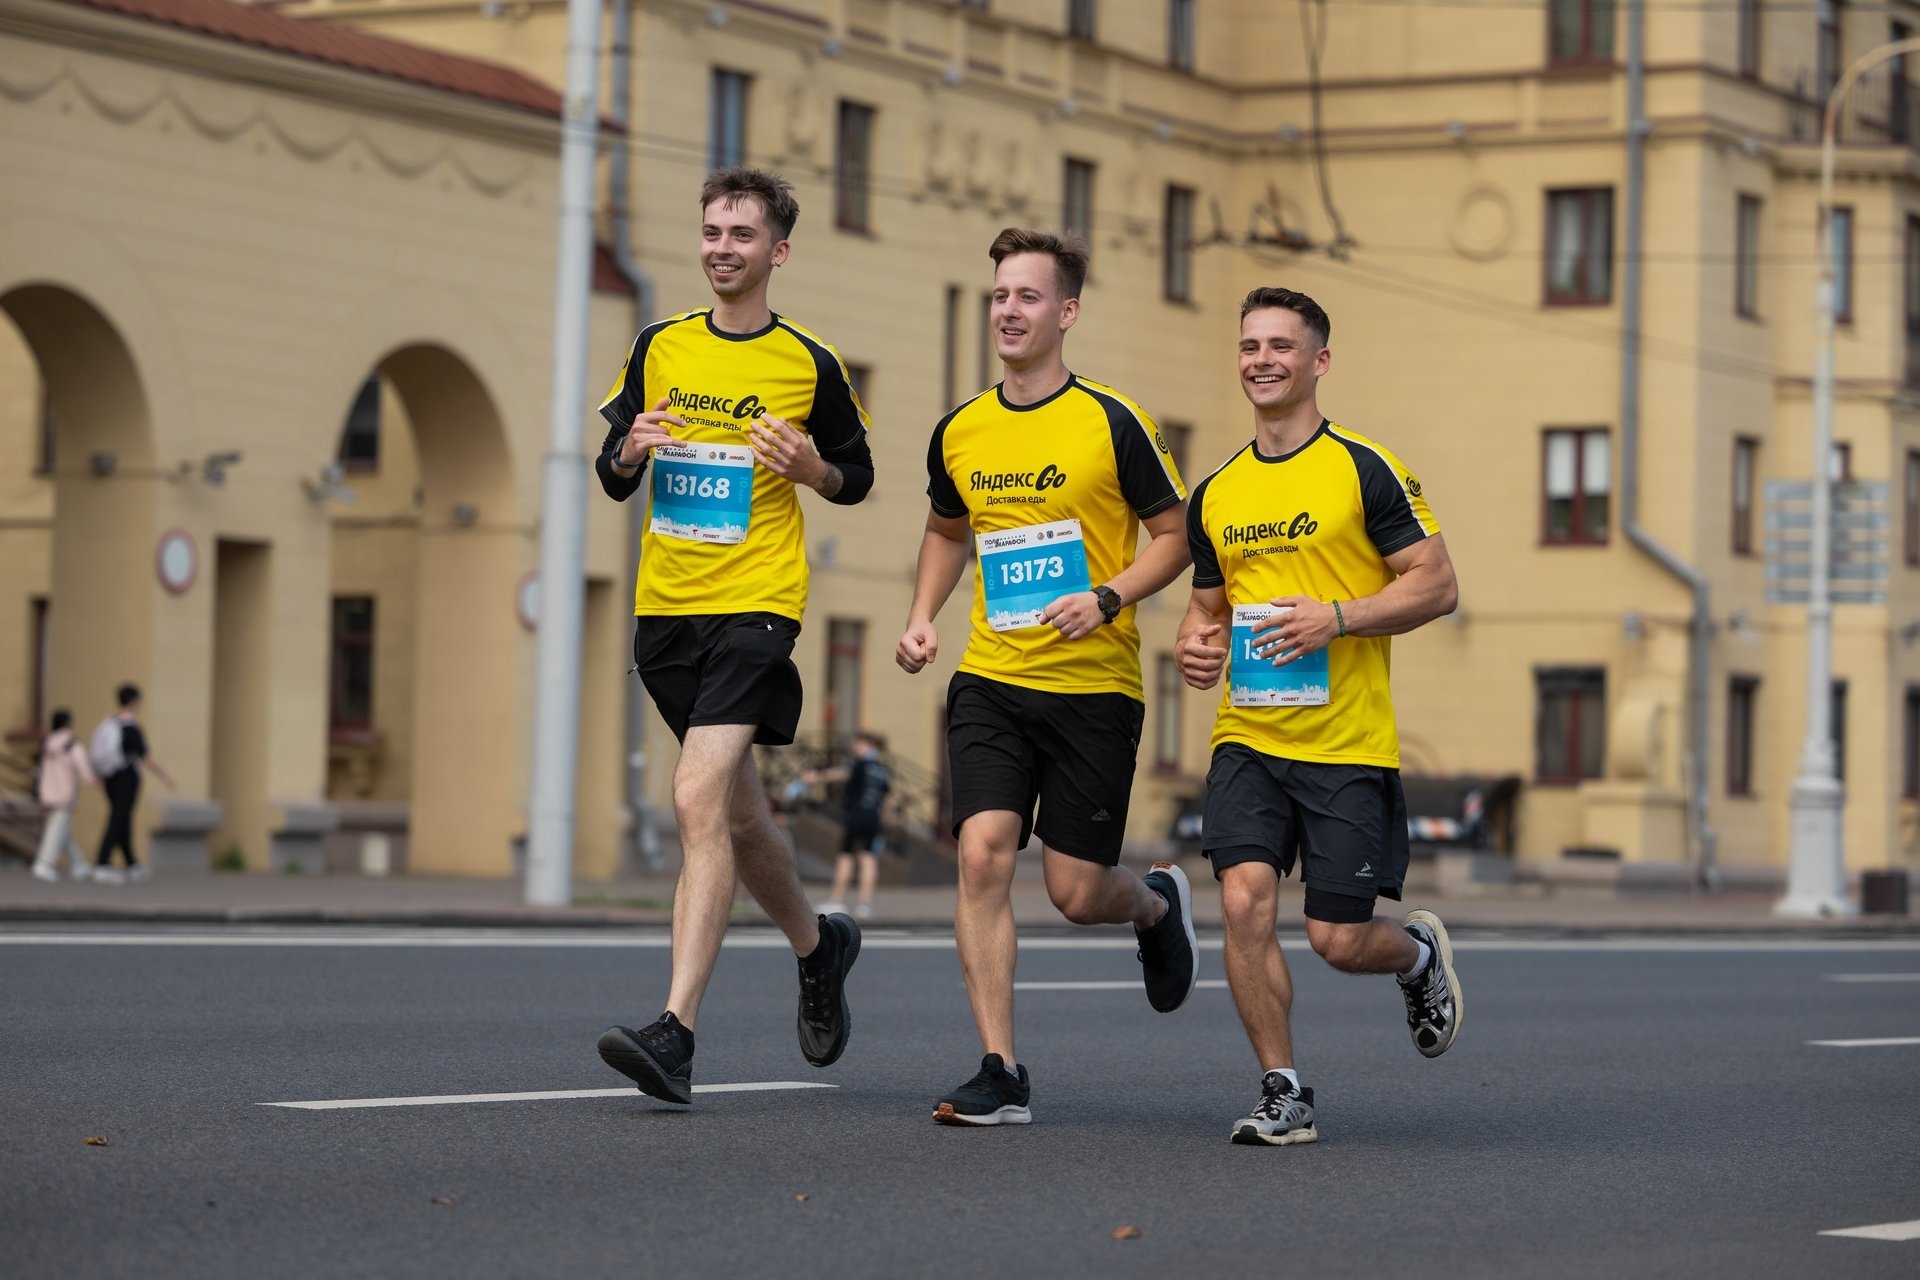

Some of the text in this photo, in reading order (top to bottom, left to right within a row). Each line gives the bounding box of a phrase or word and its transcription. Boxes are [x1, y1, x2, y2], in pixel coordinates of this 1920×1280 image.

[668, 387, 767, 419] Яндекс Go
[723, 422, 742, 432] еды
[666, 473, 730, 499] 13168
[970, 464, 1067, 492] Яндекс Go
[986, 496, 1046, 506] Доставка еды
[1223, 511, 1318, 547] Яндекс Go
[997, 538, 1026, 548] МАРАФОН
[1242, 545, 1299, 559] Доставка еды
[1001, 555, 1064, 585] 13173
